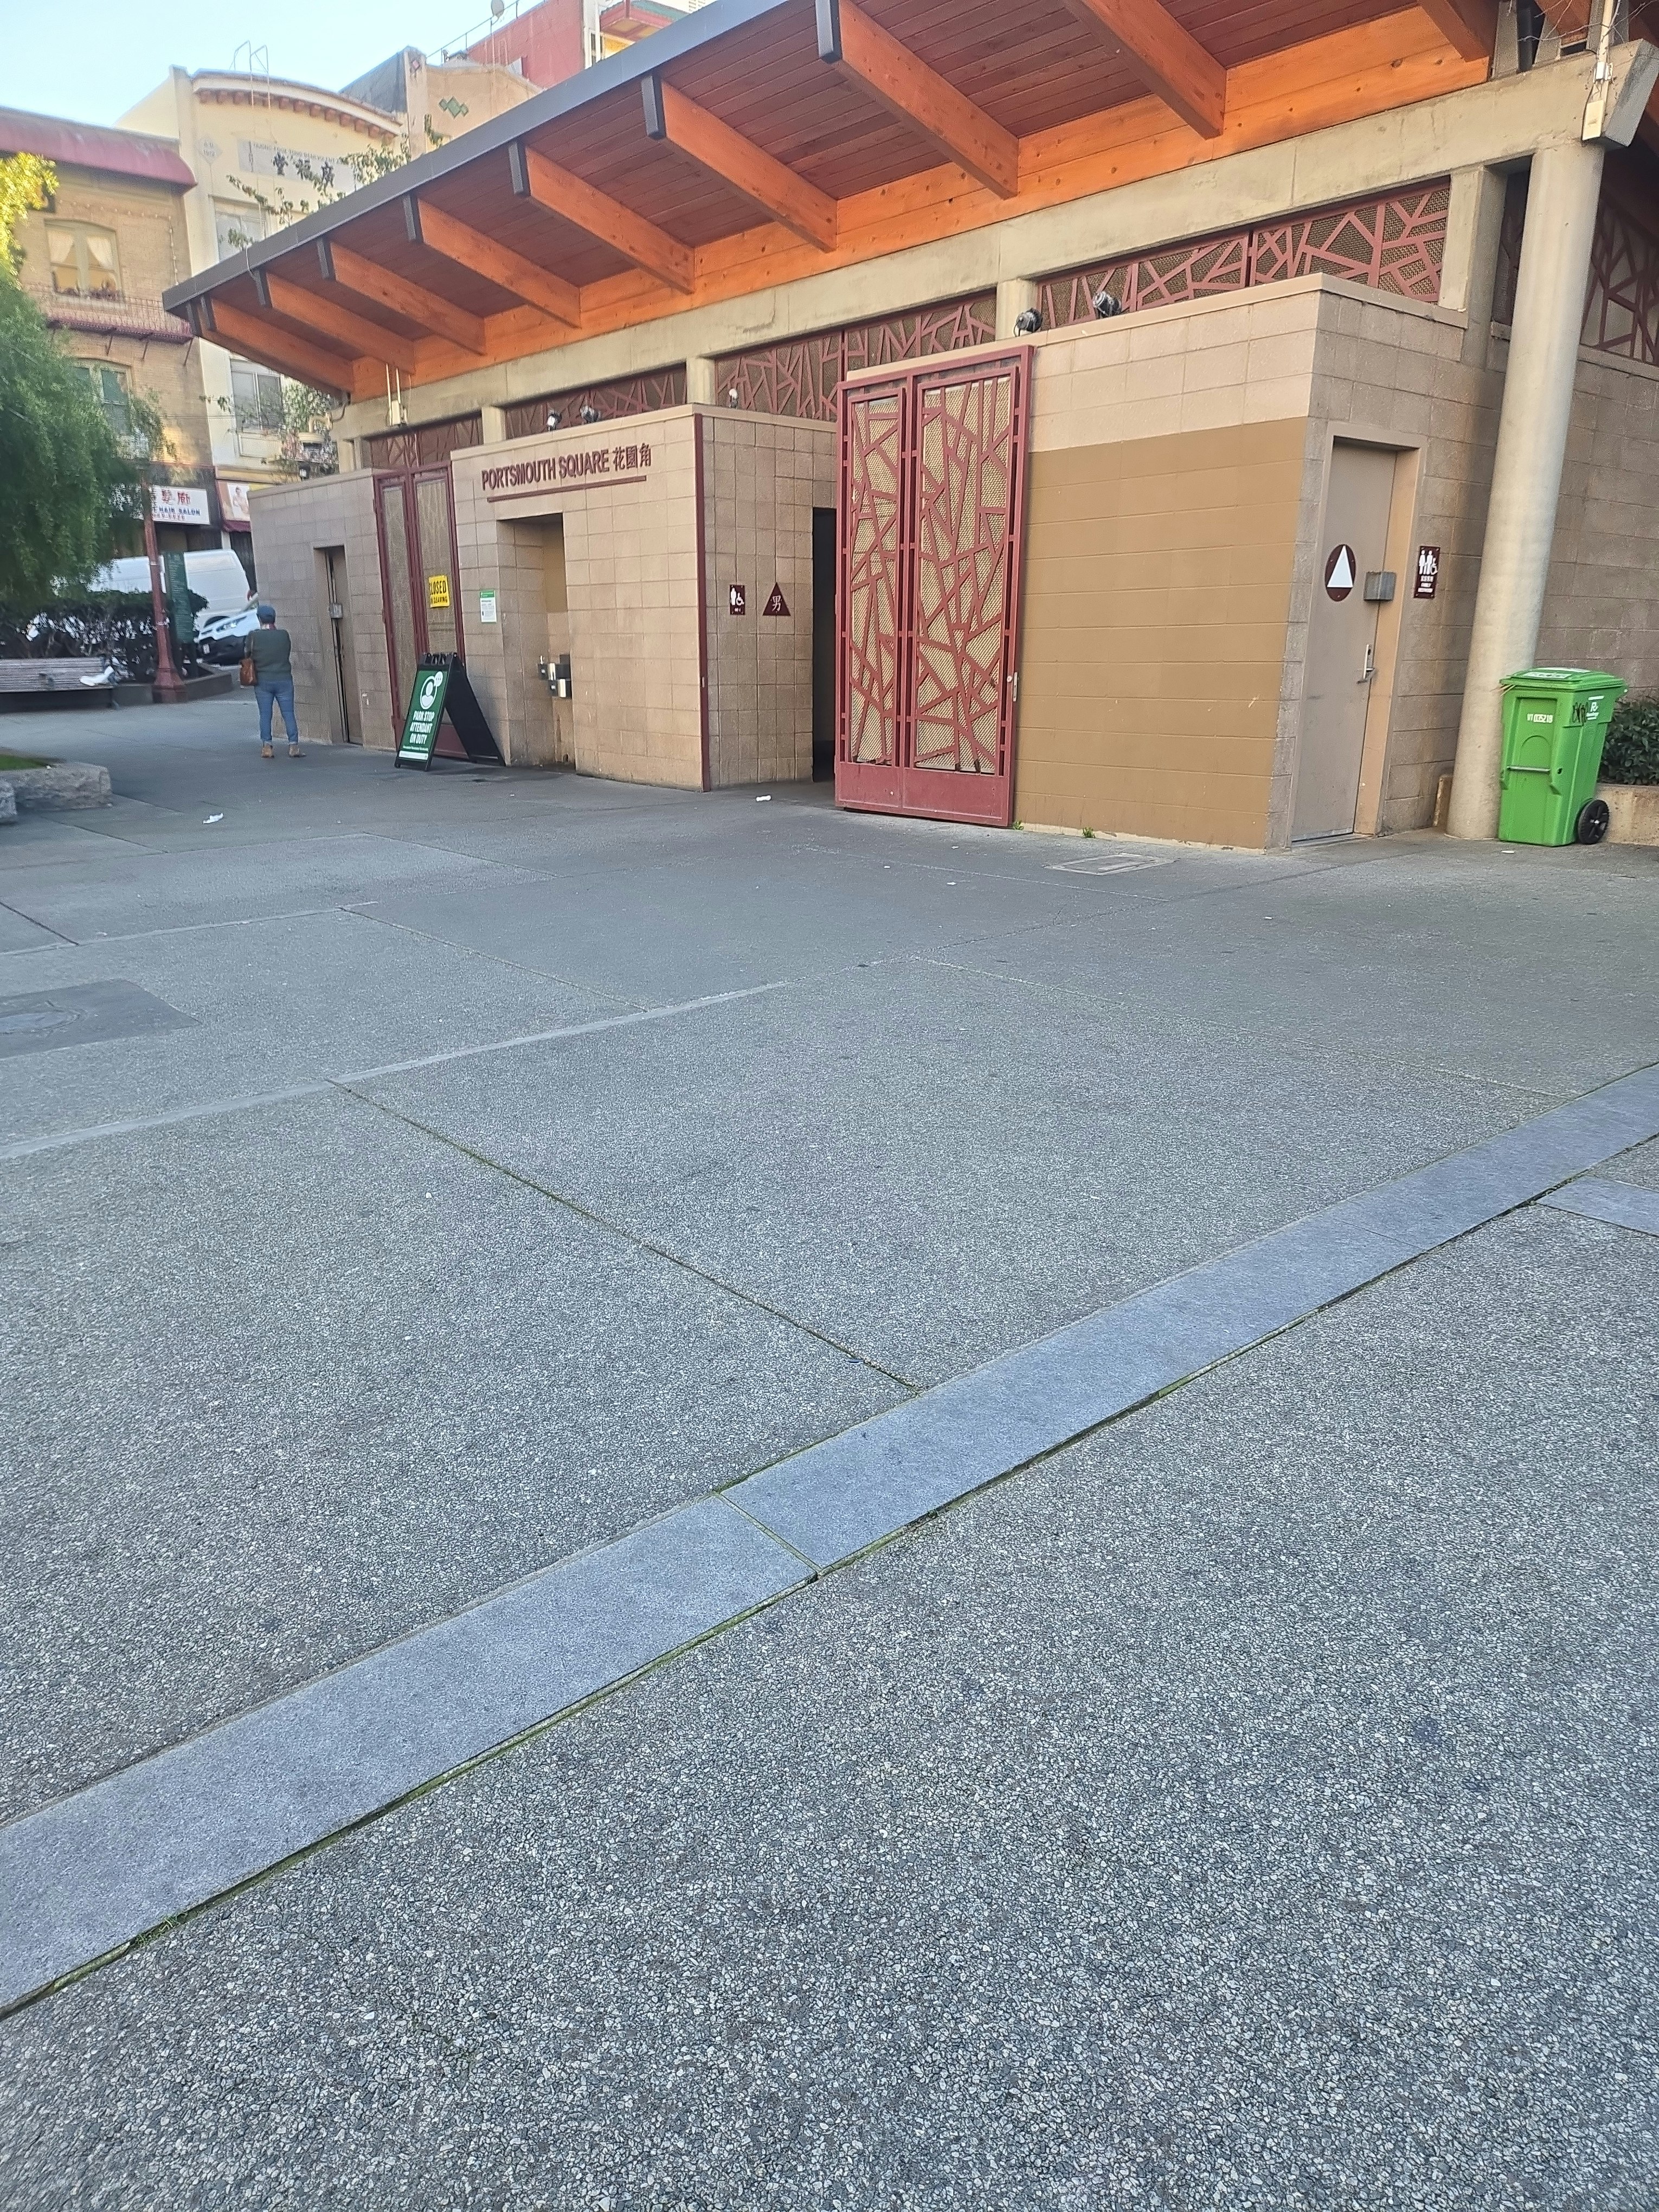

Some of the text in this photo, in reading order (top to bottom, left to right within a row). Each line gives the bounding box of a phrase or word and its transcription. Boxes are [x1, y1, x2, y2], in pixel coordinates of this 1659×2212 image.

[481, 442, 652, 491] PORTSMOUTH SQUARE 花園角
[771, 595, 781, 612] 男
[413, 710, 435, 722] PARK STOP
[409, 721, 433, 734] ATTENDANT
[409, 733, 428, 745] ON DUTY
